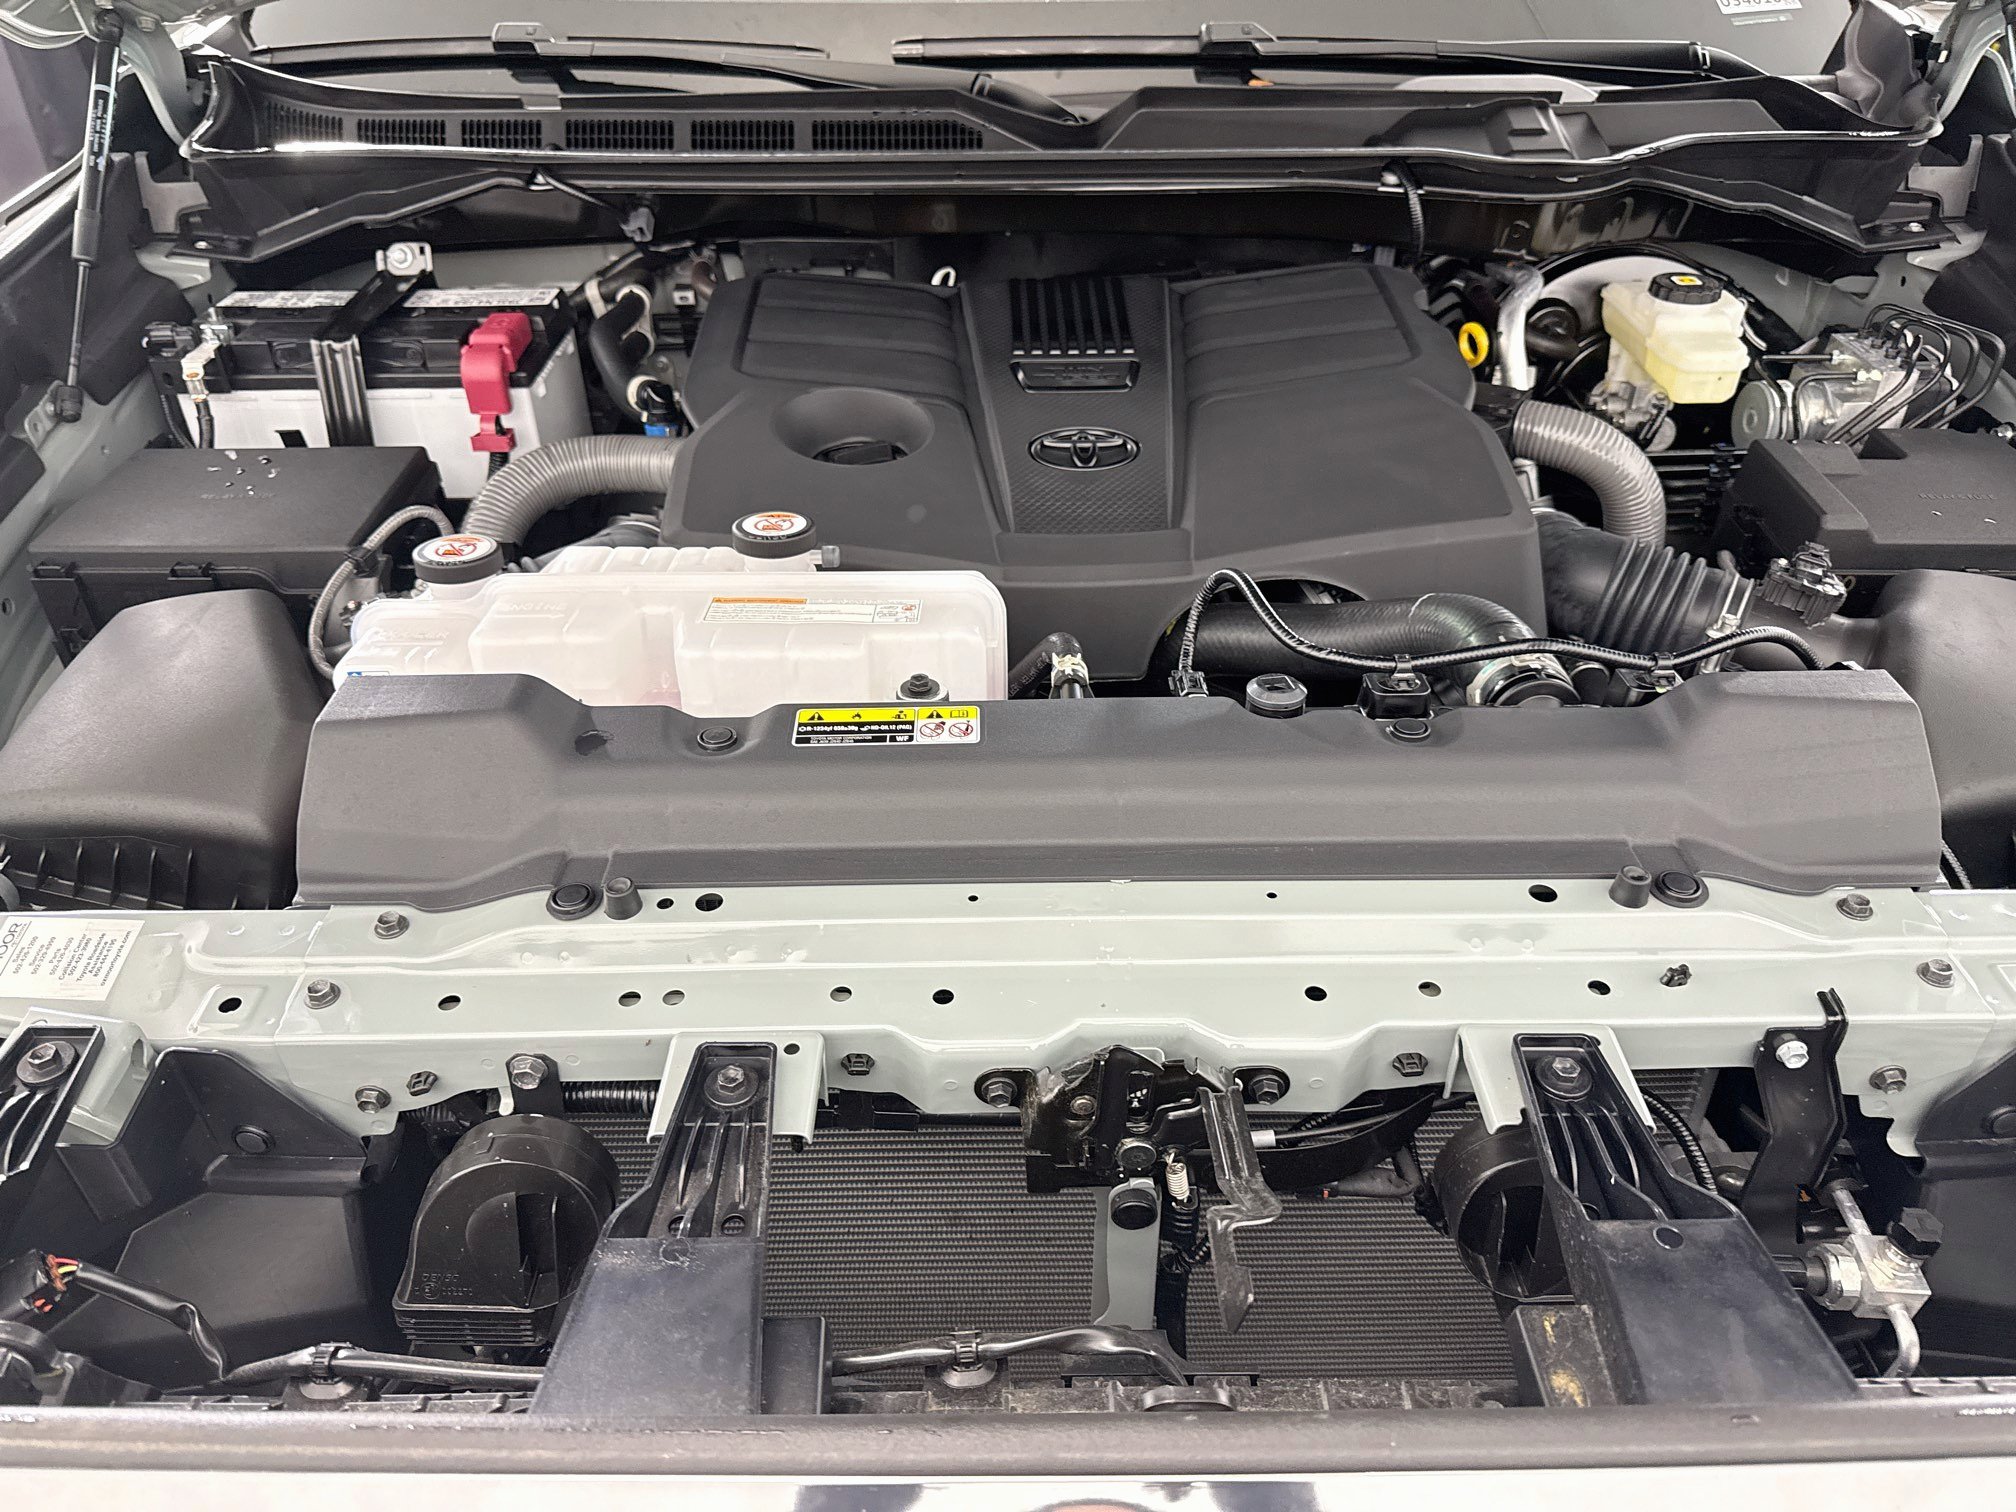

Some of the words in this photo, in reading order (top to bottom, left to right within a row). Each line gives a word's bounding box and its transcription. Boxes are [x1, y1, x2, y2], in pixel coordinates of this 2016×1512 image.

[0, 923, 22, 958] OOR
[13, 946, 26, 963] Sales
[29, 944, 45, 967] Service
[49, 948, 61, 964] Parts
[58, 952, 77, 980] Collision
[73, 933, 87, 953] Center
[76, 960, 93, 982] Toyota
[88, 932, 106, 962] Roadside
[88, 941, 109, 974] Assistance
